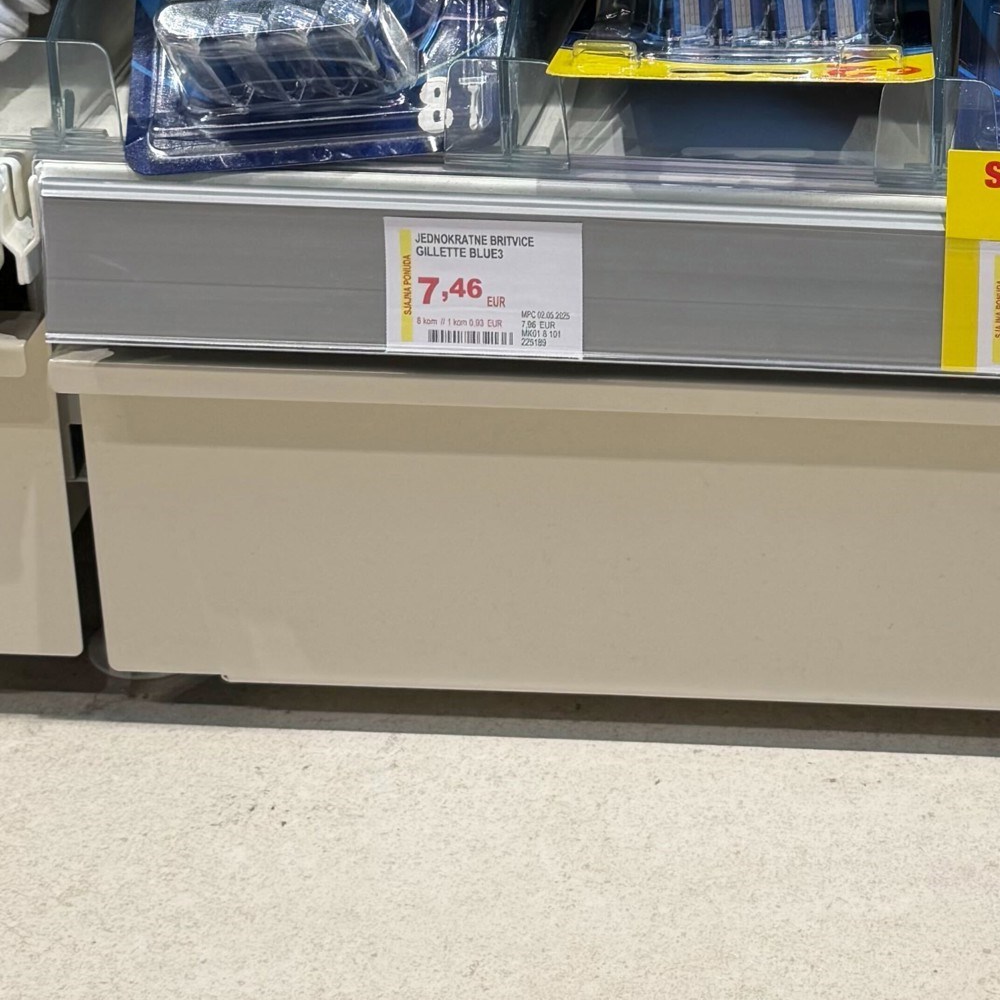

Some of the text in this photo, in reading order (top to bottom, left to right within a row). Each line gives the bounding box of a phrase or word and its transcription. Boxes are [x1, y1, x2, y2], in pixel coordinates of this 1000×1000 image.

[418, 77, 454, 134] 8
[415, 233, 534, 247] JEDNOKRATNE BRITVICE
[416, 246, 503, 259] GILLETTE BLUE3
[403, 255, 411, 285] PONUDA
[418, 277, 505, 307] 7,46 EUR
